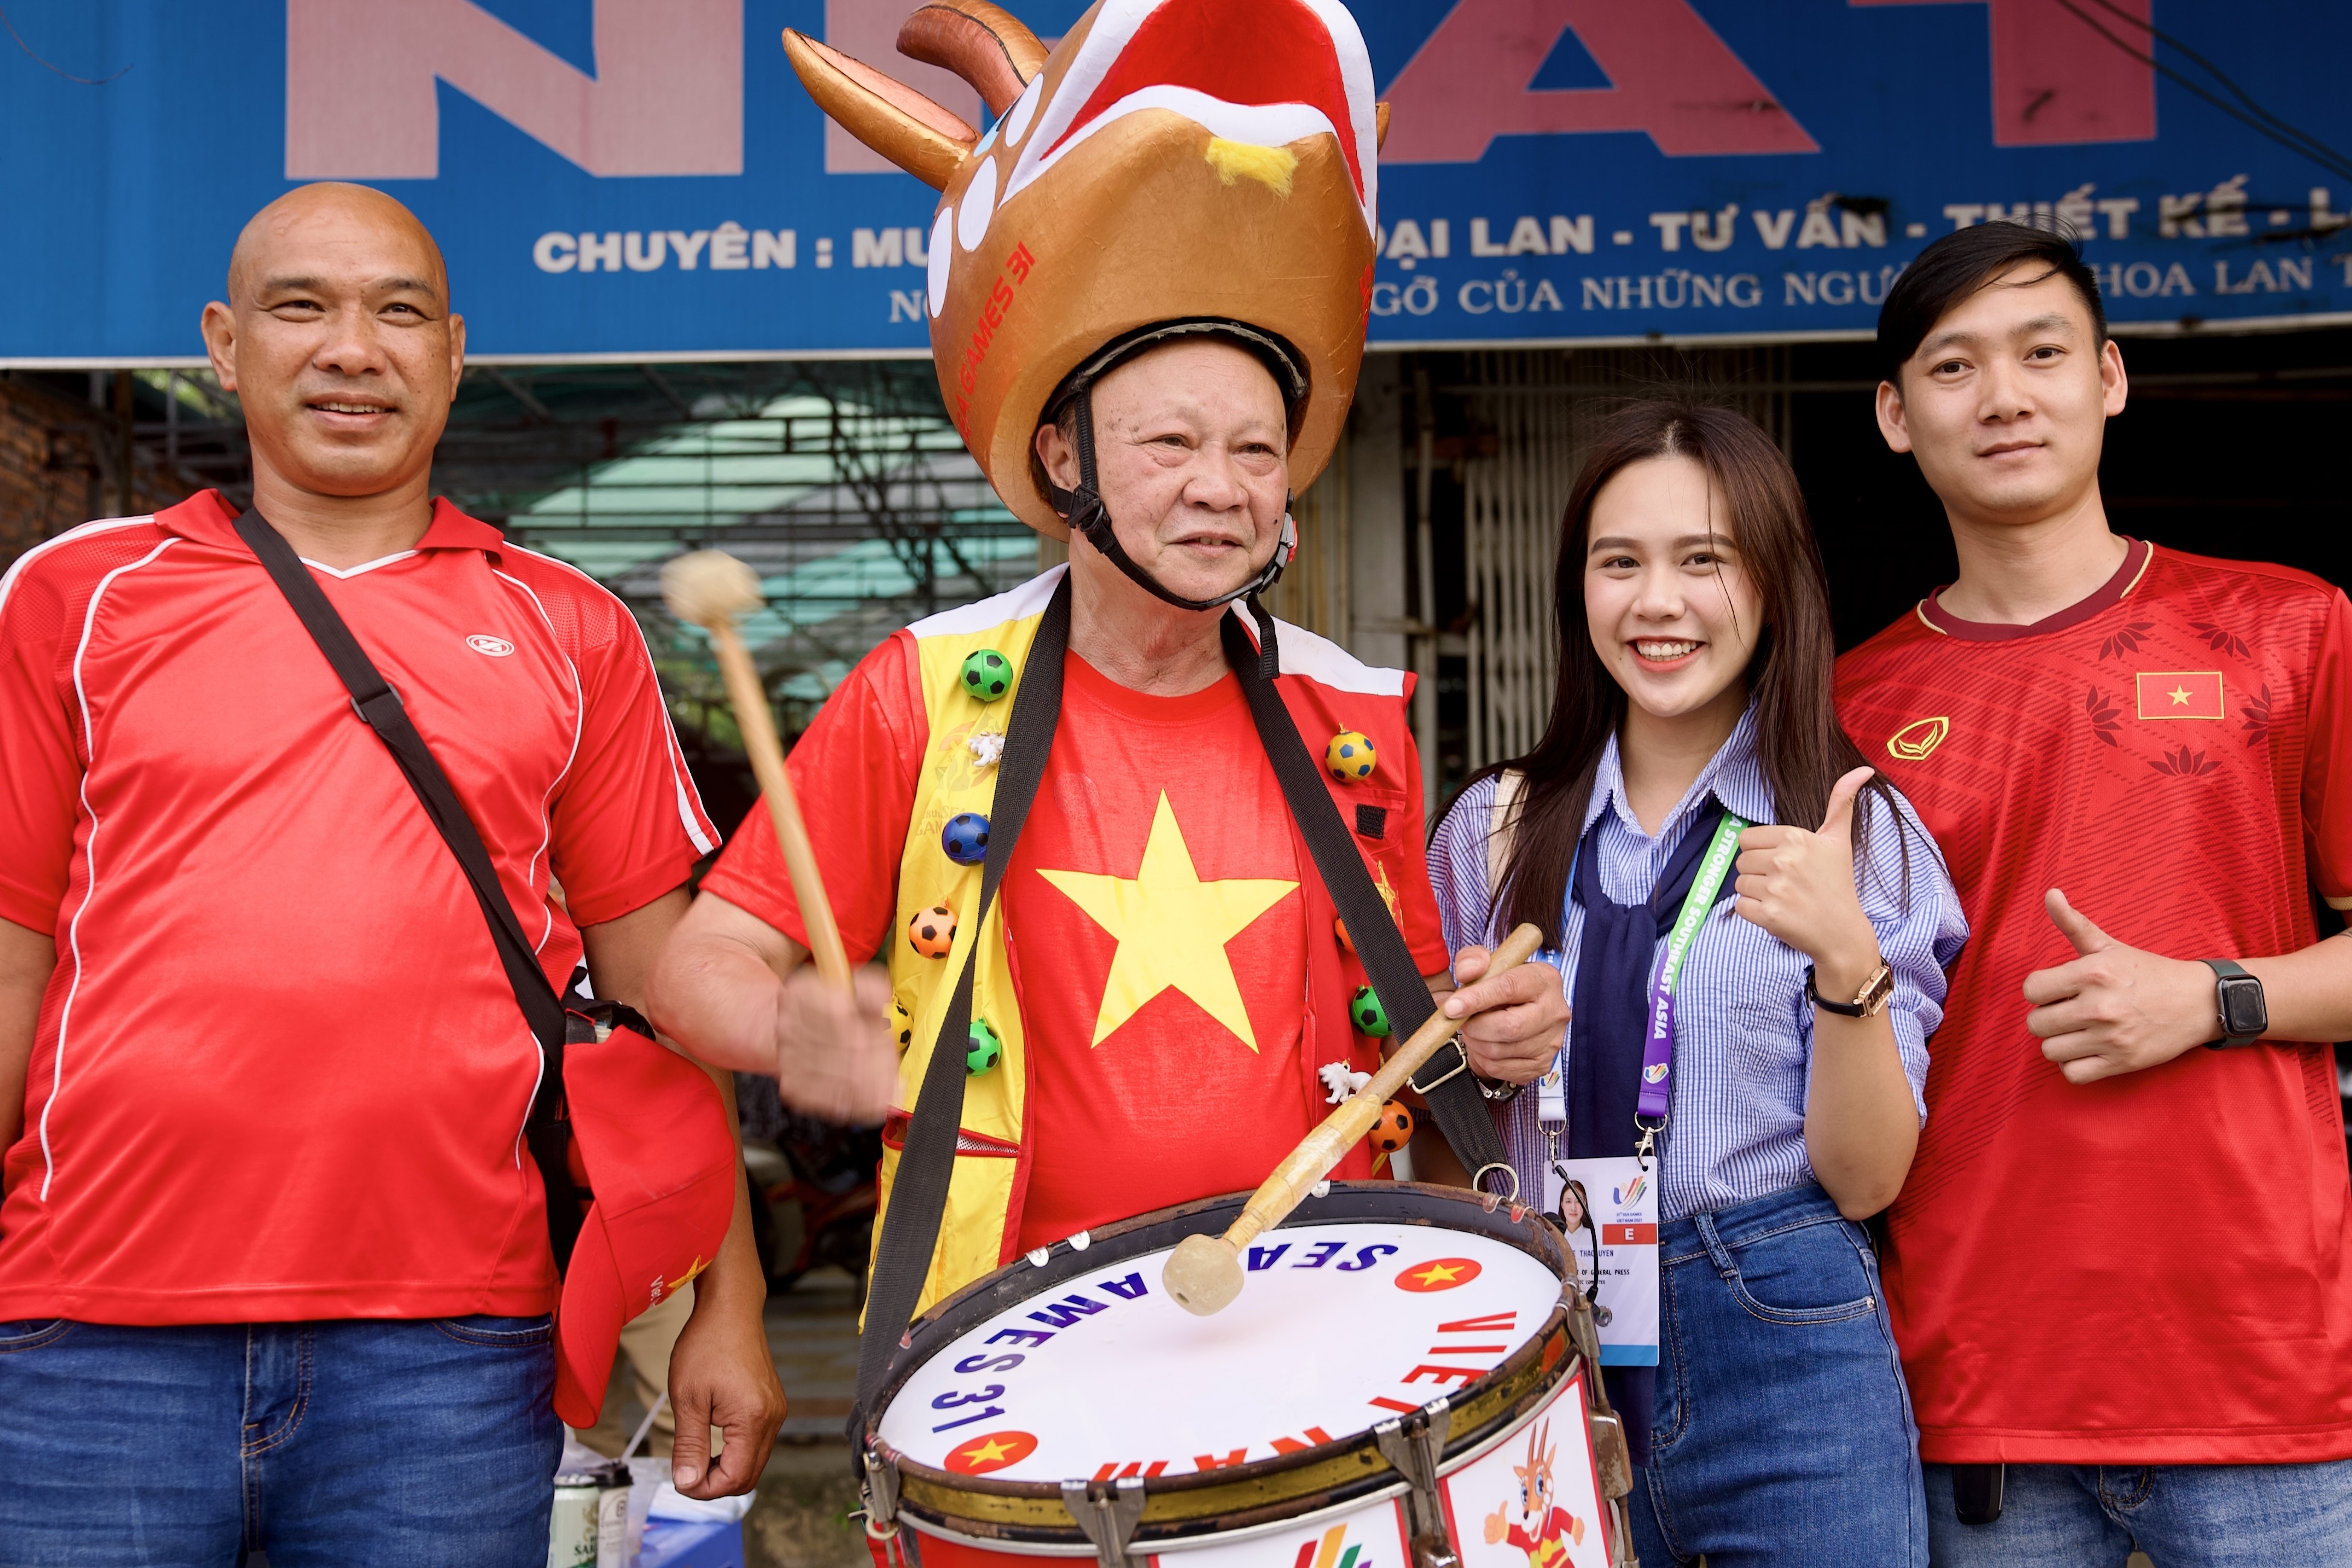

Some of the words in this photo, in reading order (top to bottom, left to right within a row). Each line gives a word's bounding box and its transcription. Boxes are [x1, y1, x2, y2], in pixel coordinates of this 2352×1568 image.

[533, 221, 796, 274] CHUYÊN
[1470, 214, 1595, 258] LAN
[1649, 202, 1740, 252] TƯ
[1752, 191, 1888, 250] VẤN
[1458, 267, 1565, 314] CỦA
[1580, 267, 1763, 310] NHỮNG
[2213, 255, 2314, 295] LAN
[960, 274, 1014, 396] GAMES
[1005, 240, 1036, 286] 31
[1729, 816, 1743, 828] A
[1696, 827, 1737, 906] STRONGER
[1659, 905, 1702, 996] SOUTHEAST
[1653, 996, 1669, 1040] ASIA
[1248, 1242, 1399, 1272] SEA
[1624, 1227, 1635, 1240] E
[954, 1272, 1149, 1374] AMES
[931, 1384, 1005, 1433] 31
